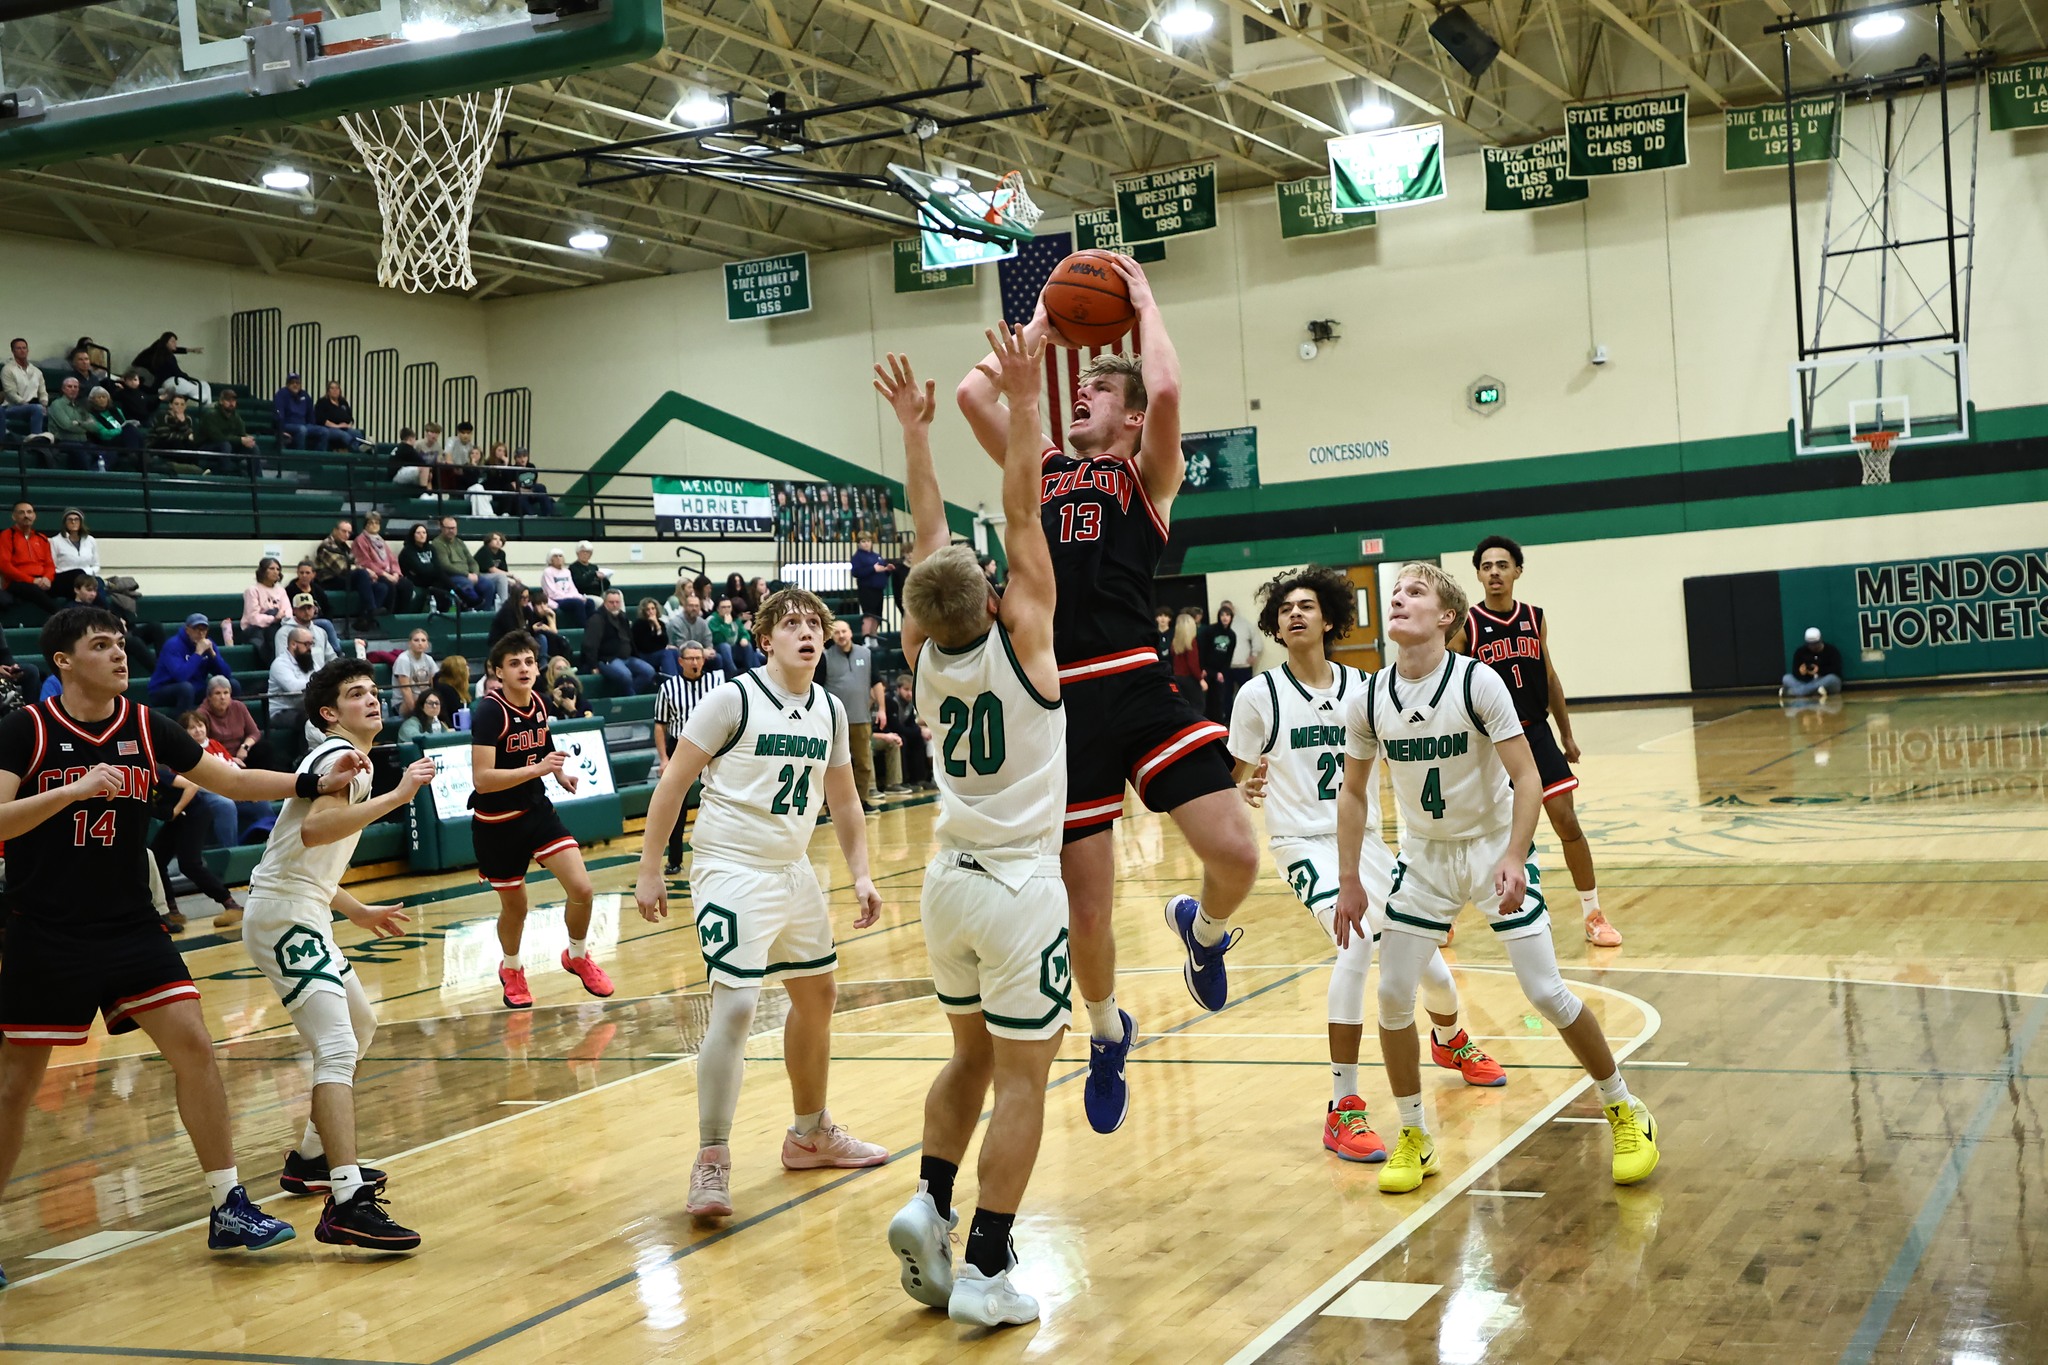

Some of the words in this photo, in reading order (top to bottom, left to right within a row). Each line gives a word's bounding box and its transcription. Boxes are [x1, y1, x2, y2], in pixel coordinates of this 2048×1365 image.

[1989, 69, 2022, 85] STATE
[2028, 66, 2048, 80] TRA
[2014, 83, 2048, 99] CLA
[1568, 107, 1609, 125] STATE
[1614, 99, 1683, 120] FOOTBALL
[1726, 111, 1756, 127] STATE
[1800, 101, 1836, 118] CHAMP
[2033, 100, 2048, 114] 19
[1586, 118, 1666, 140] CHAMPIONS
[1748, 122, 1799, 141] CLASS
[1808, 120, 1818, 134] D
[1487, 148, 1524, 162] STATE
[1532, 139, 1566, 157] CHAM
[1587, 139, 1632, 157] CLASS
[1503, 155, 1566, 175] FOOTBALL
[1612, 155, 1643, 172] 1991
[1116, 176, 1148, 193] STATE
[1152, 164, 1214, 188] RUNNER-UP
[1283, 180, 1311, 196] STATE
[1506, 171, 1548, 189] CLASS
[1135, 183, 1197, 206] WRESTLING
[1305, 190, 1332, 205] TRA
[1521, 184, 1553, 201] 1972
[1078, 211, 1111, 226] STATE
[1142, 202, 1179, 219] CLASS
[1183, 198, 1193, 212] D
[1299, 202, 1332, 217] CLAS
[1093, 222, 1120, 237] FOOT
[1156, 216, 1182, 232] 1990
[1313, 213, 1344, 228] 1972
[1095, 235, 1120, 249] CLAS
[737, 258, 793, 276] FOOTBALL
[732, 276, 755, 290] STATE
[758, 271, 788, 287] RUNNER
[789, 269, 800, 282] UP
[743, 286, 780, 302] CLASS
[783, 284, 792, 297] D
[756, 300, 782, 314] 1956
[1309, 440, 1390, 464] CONCESSIONS
[680, 480, 744, 494] MENDON
[1040, 462, 1134, 516] COLON
[681, 498, 748, 514] HORNET
[674, 518, 762, 531] BASKETBALL
[1060, 502, 1102, 543] 13
[1855, 552, 2048, 608] MENDON
[1477, 636, 1540, 665] COLON
[1511, 664, 1523, 688] 1
[505, 727, 547, 753] COLO
[939, 690, 1006, 777] 20
[1290, 725, 1346, 750] MENDO
[754, 733, 828, 761] MENDON
[1383, 731, 1469, 762] MENDON
[38, 764, 150, 803] COON
[770, 764, 813, 816] 24
[1421, 767, 1446, 819] 4
[73, 810, 116, 846] 14
[700, 920, 724, 948] M
[286, 939, 320, 965] M
